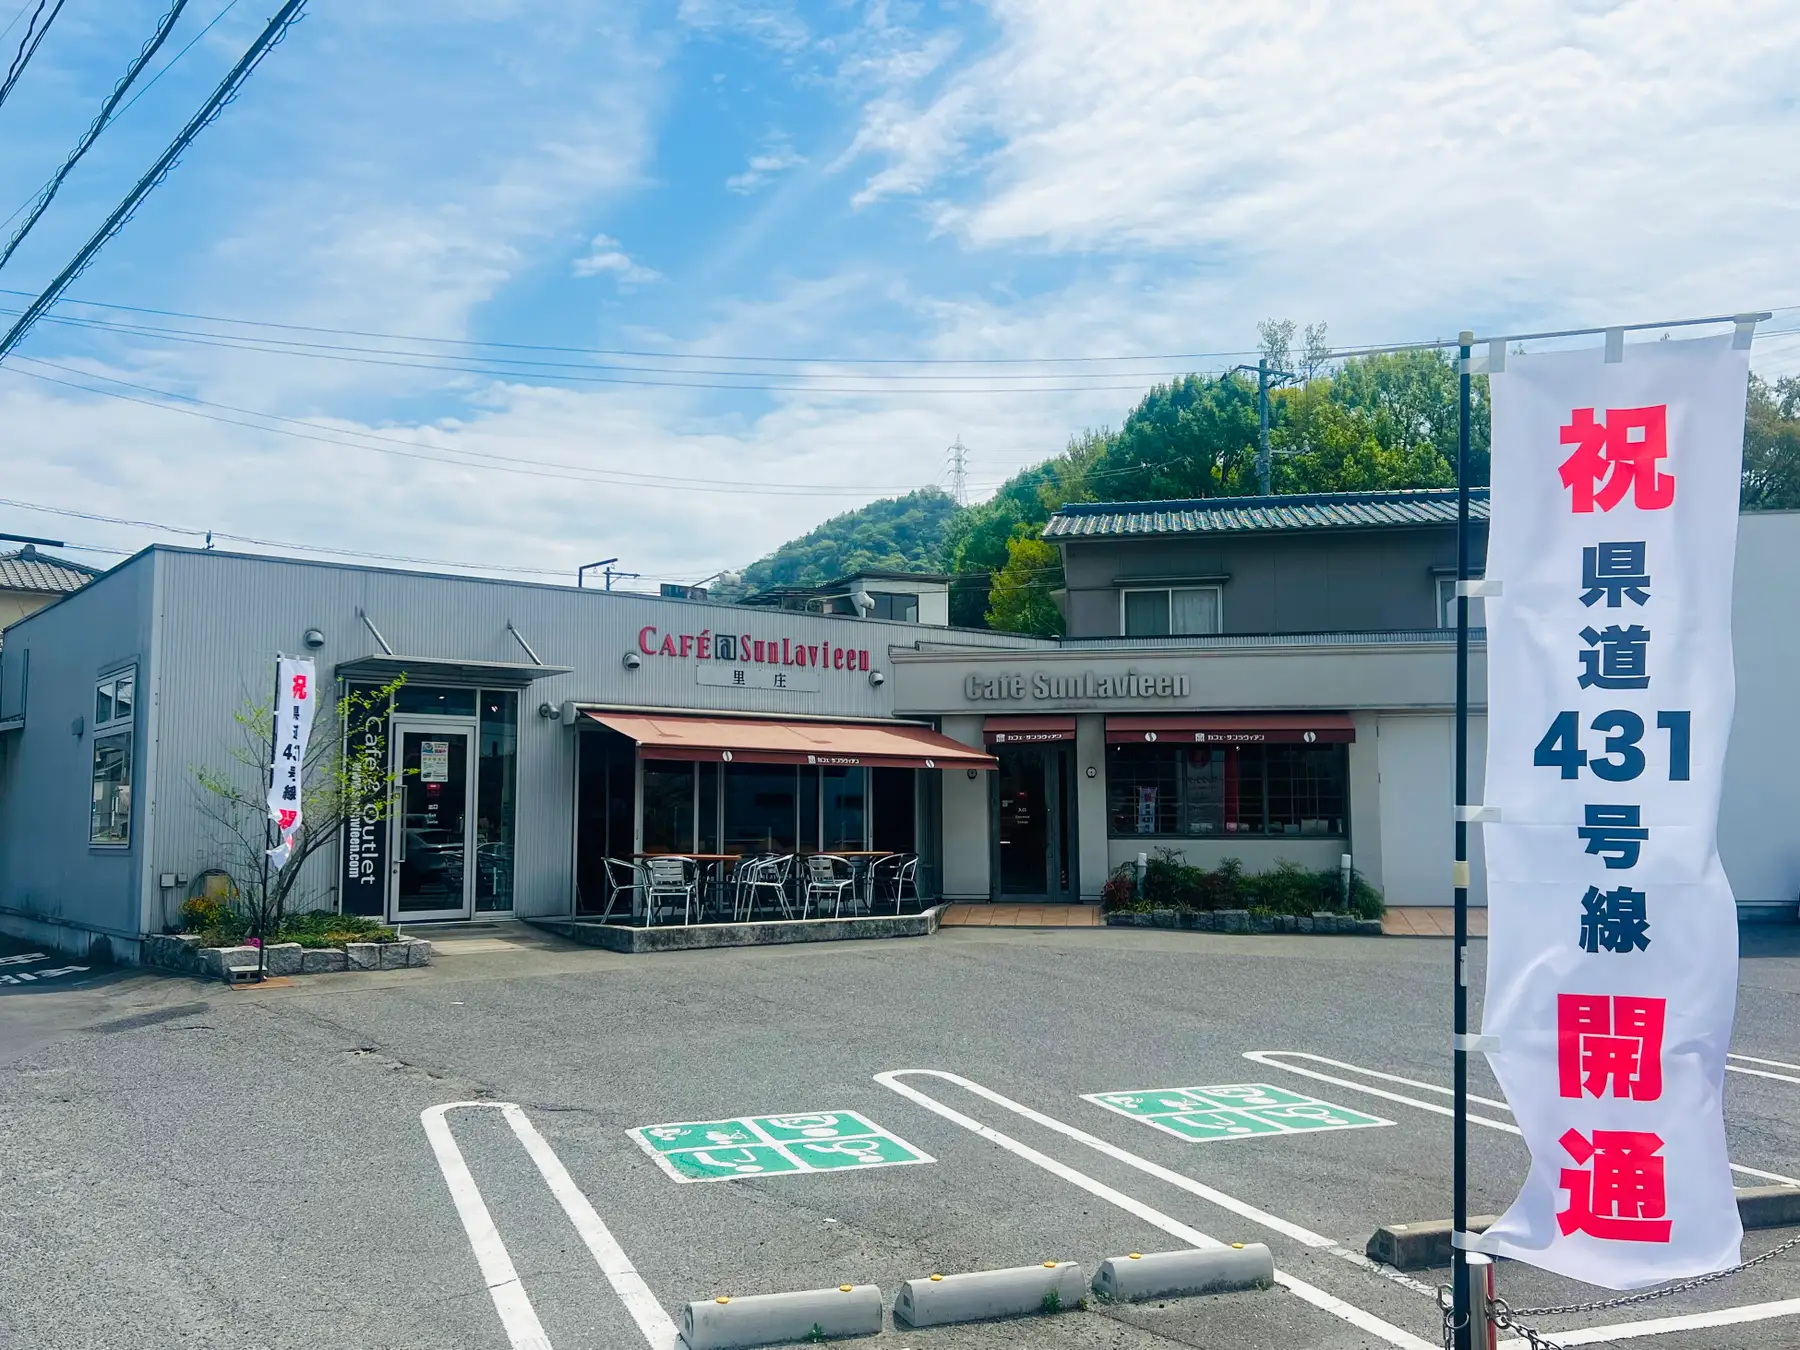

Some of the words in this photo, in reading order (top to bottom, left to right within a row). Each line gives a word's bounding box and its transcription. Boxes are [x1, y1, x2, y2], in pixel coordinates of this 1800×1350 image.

[965, 671, 1027, 701] Café
[1033, 667, 1191, 700] SunLavieen
[361, 804, 380, 885] Outlet
